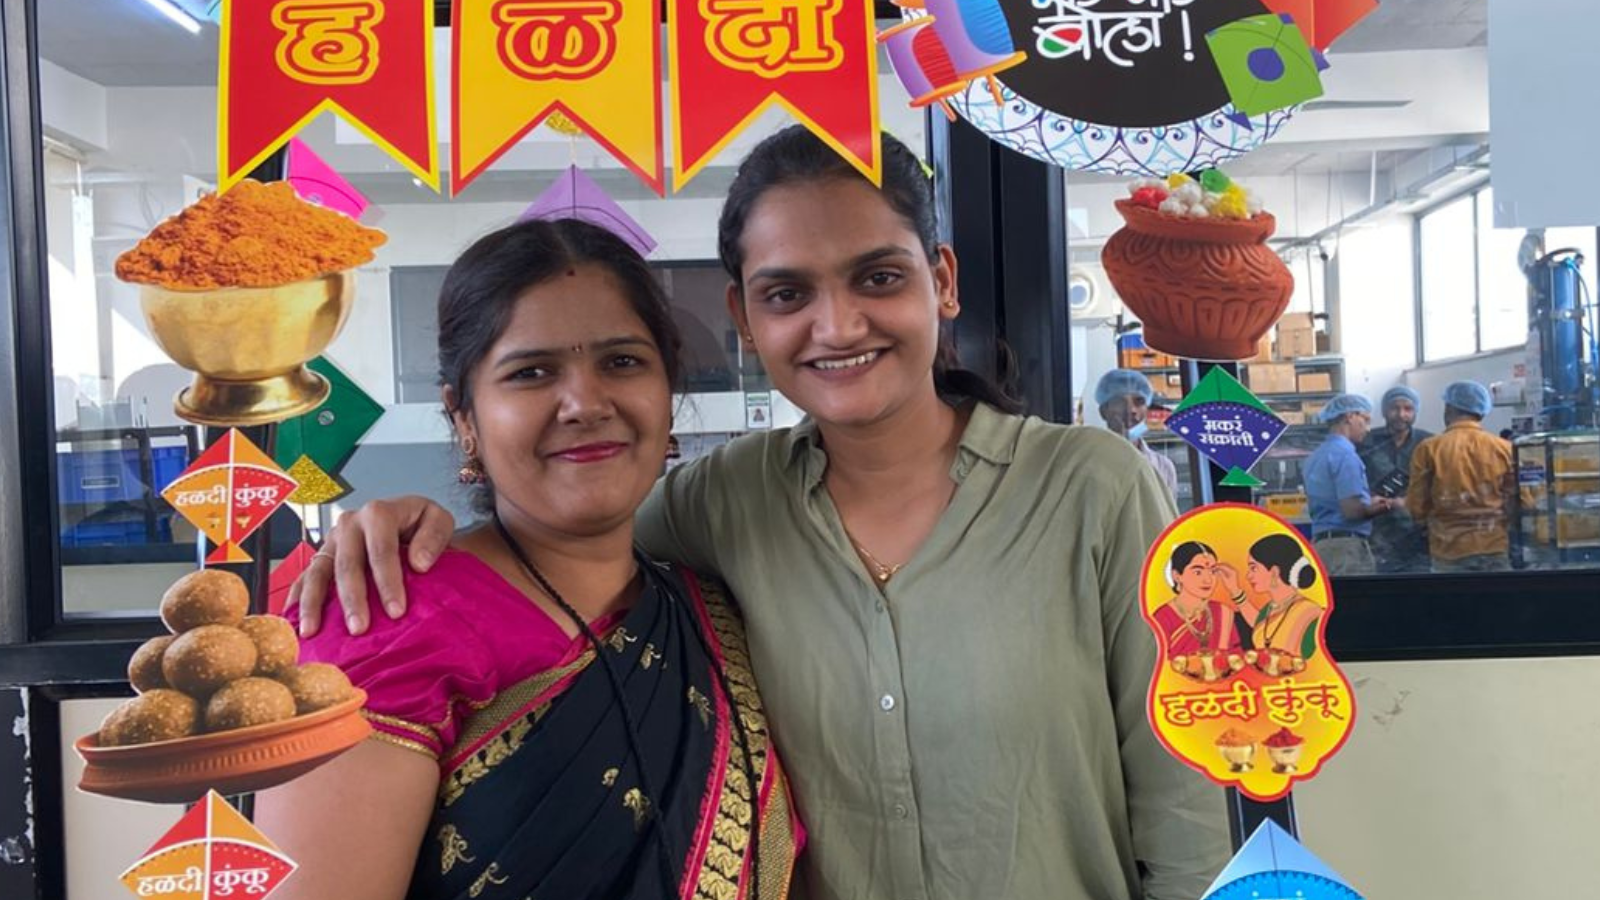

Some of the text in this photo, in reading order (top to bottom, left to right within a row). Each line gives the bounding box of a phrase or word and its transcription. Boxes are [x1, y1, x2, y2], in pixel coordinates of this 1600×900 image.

[175, 483, 280, 508] हळदी कुंकू
[1160, 677, 1345, 727] हळदी कुंकू
[137, 863, 271, 896] हळदी कुंकू
